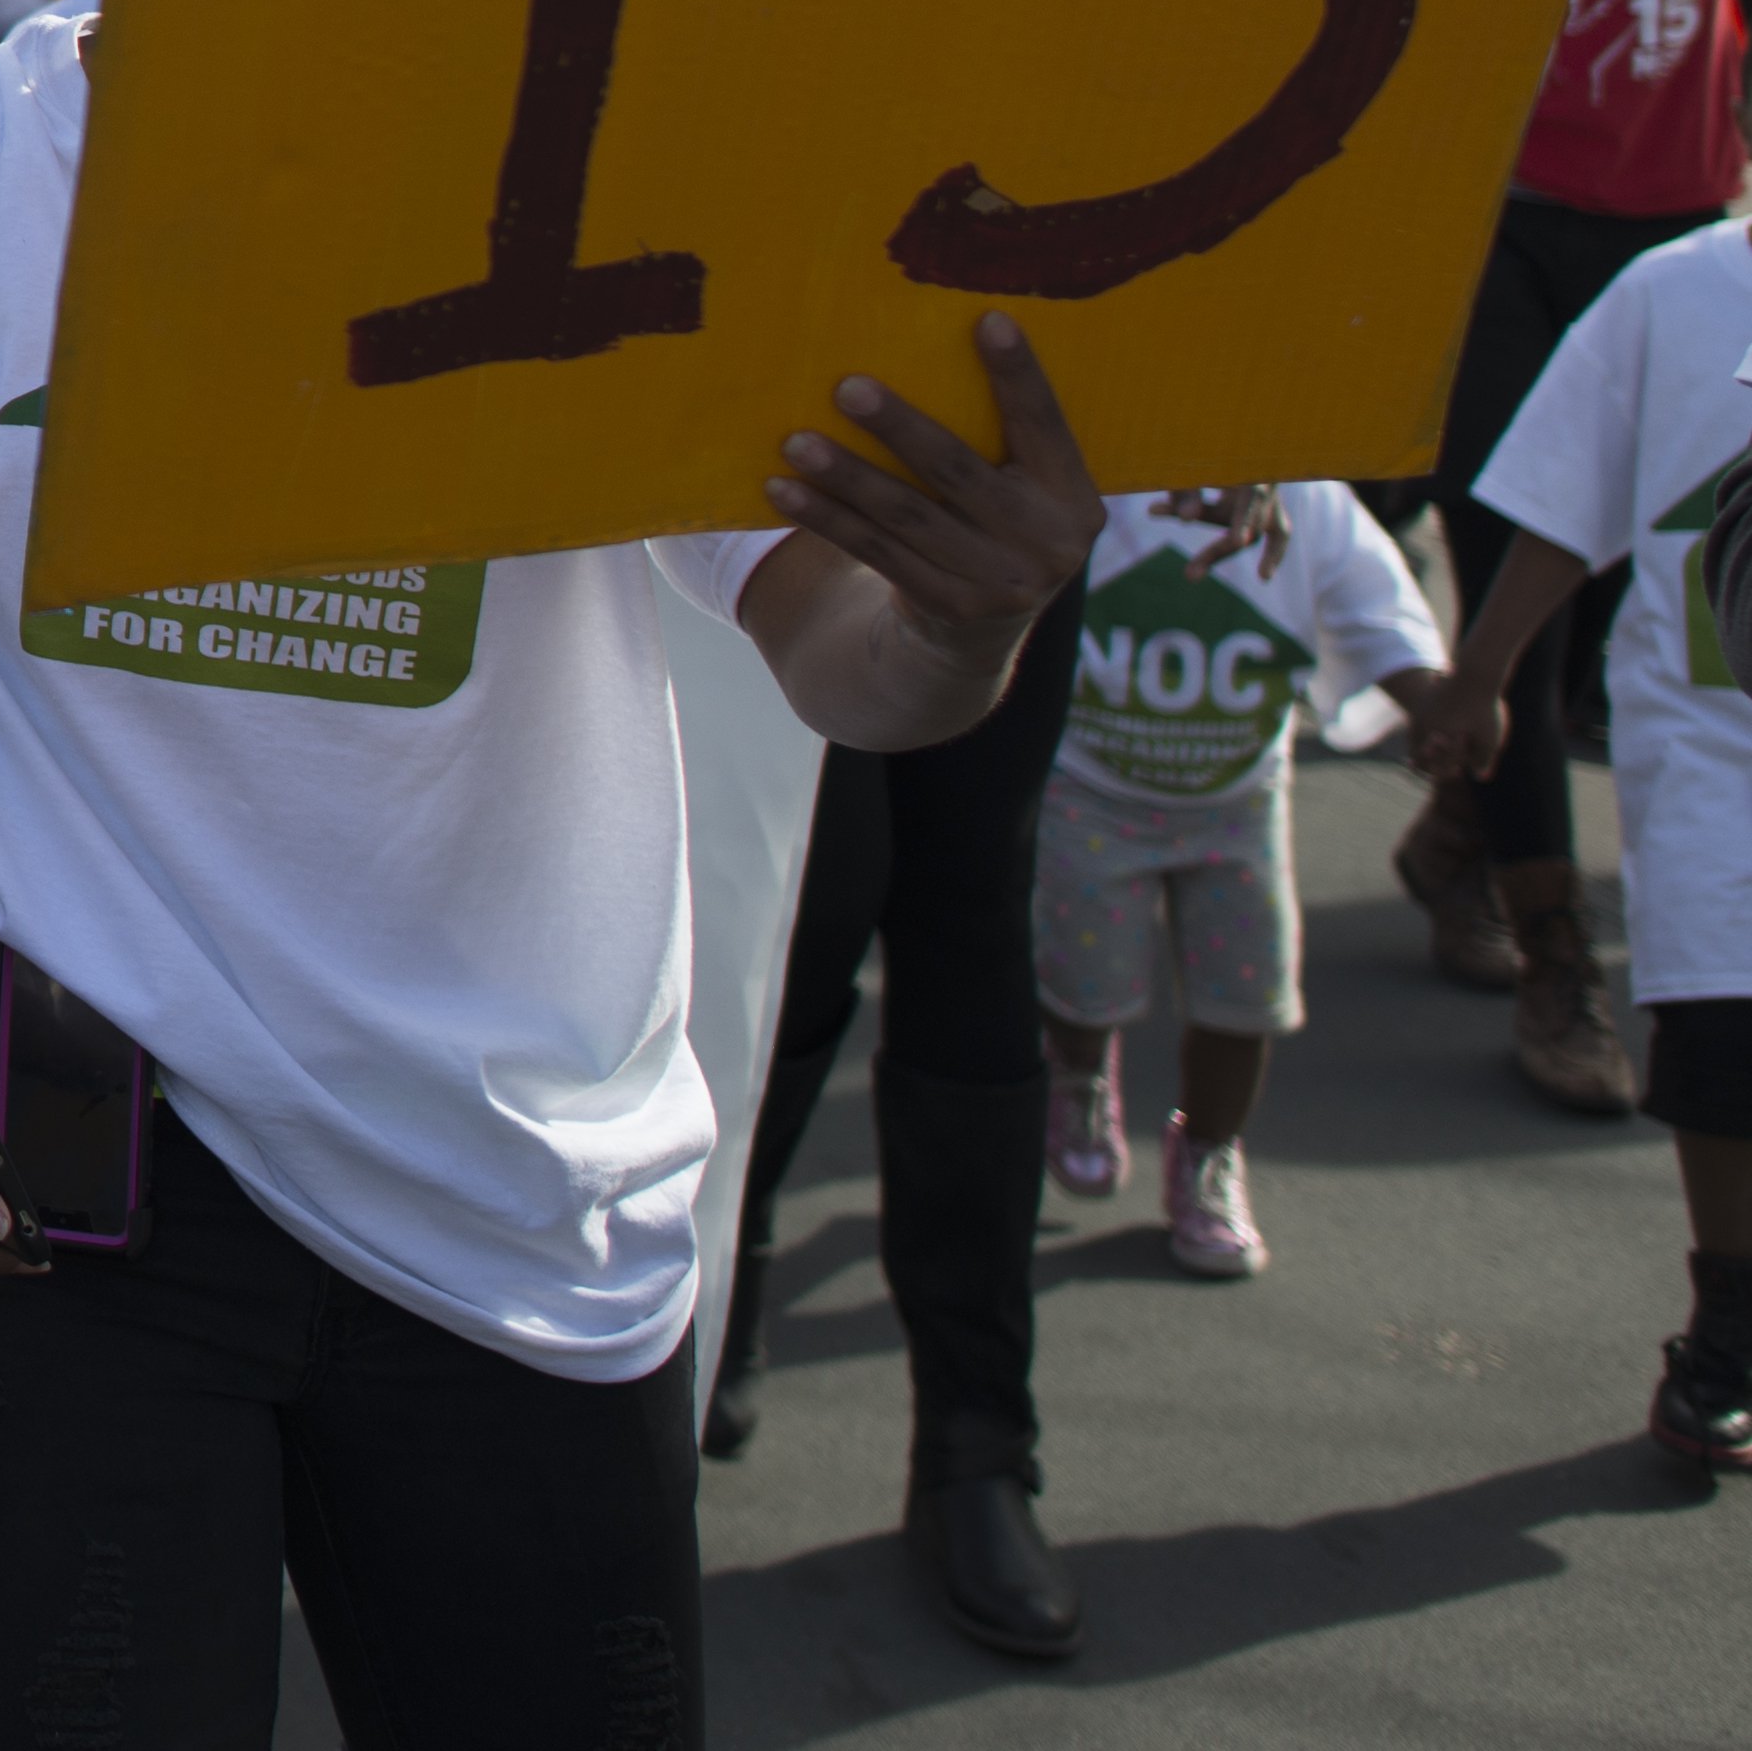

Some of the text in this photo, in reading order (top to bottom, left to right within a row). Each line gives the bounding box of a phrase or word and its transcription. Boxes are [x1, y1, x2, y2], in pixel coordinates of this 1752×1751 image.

[83, 605, 418, 681] FOR CHANGE
[1076, 624, 1275, 714] NOC
